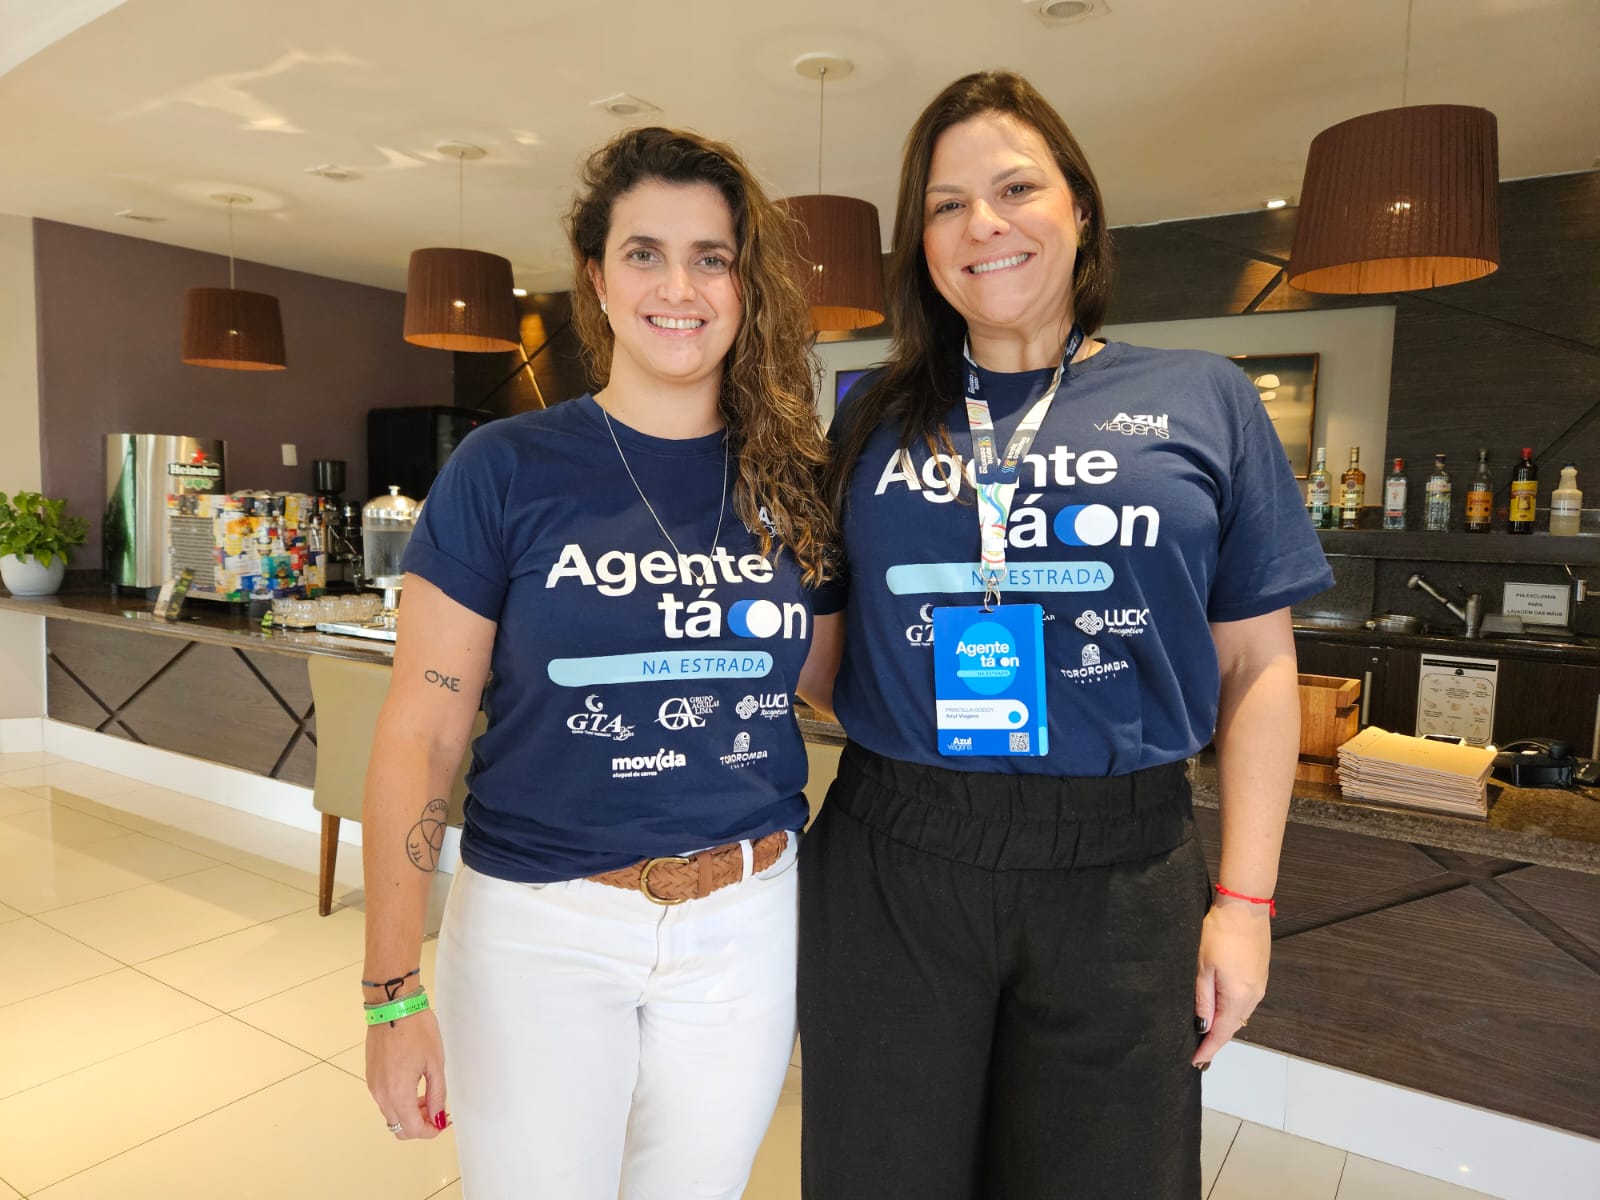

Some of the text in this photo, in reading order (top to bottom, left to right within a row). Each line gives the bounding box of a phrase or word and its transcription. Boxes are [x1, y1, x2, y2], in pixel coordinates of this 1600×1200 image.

[1093, 420, 1170, 440] viagens
[1112, 412, 1169, 429] Azul
[874, 445, 1118, 504] Agnte
[1003, 493, 1048, 549] á
[545, 543, 774, 597] Agente
[971, 569, 1106, 586] NA ESTRADA
[657, 588, 722, 639] tá
[1104, 608, 1150, 627] LUCK
[905, 624, 935, 642] GT
[955, 641, 1010, 657] Agente
[643, 657, 766, 675] NA ESTRADA
[980, 653, 996, 668] tá
[1060, 660, 1129, 679] TOROROMBA
[424, 670, 461, 692] OXE
[690, 695, 714, 703] GRUPO
[566, 713, 622, 732] GTA
[612, 747, 687, 771] movida
